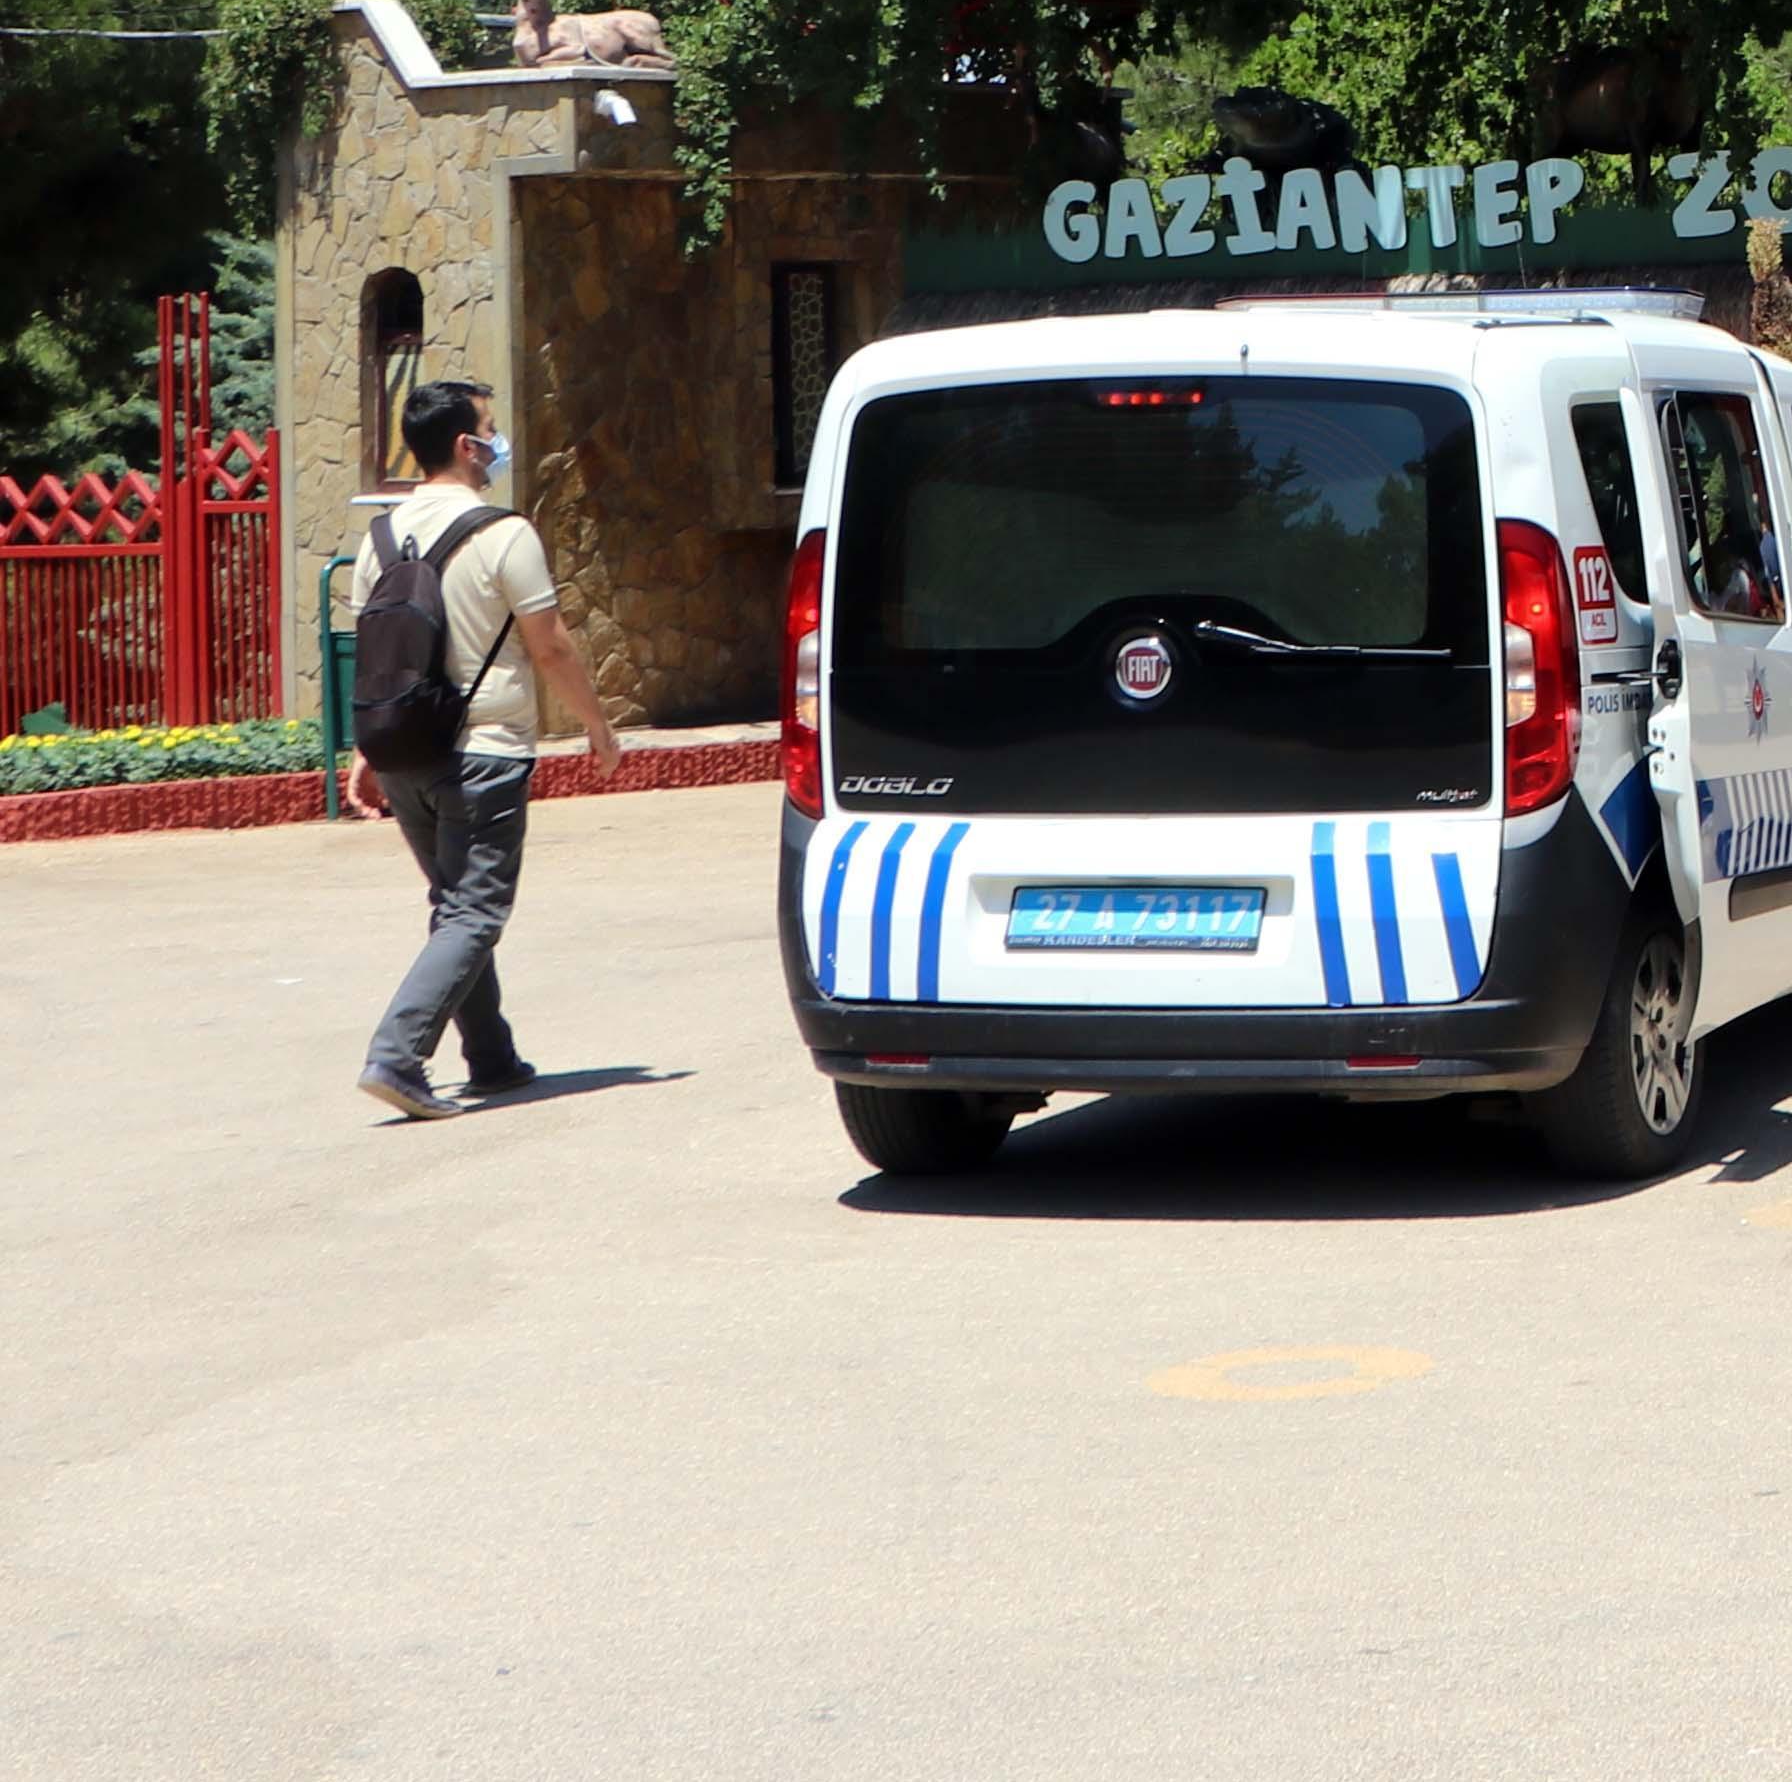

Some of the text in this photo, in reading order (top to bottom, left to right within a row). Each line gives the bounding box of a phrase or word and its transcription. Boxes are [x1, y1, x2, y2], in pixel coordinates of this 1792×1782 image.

[1043, 156, 1584, 263] GAZİANTEP
[1578, 556, 1610, 603] 112
[1127, 655, 1160, 683] FIAT
[1031, 893, 1255, 934] 27 A 73117
